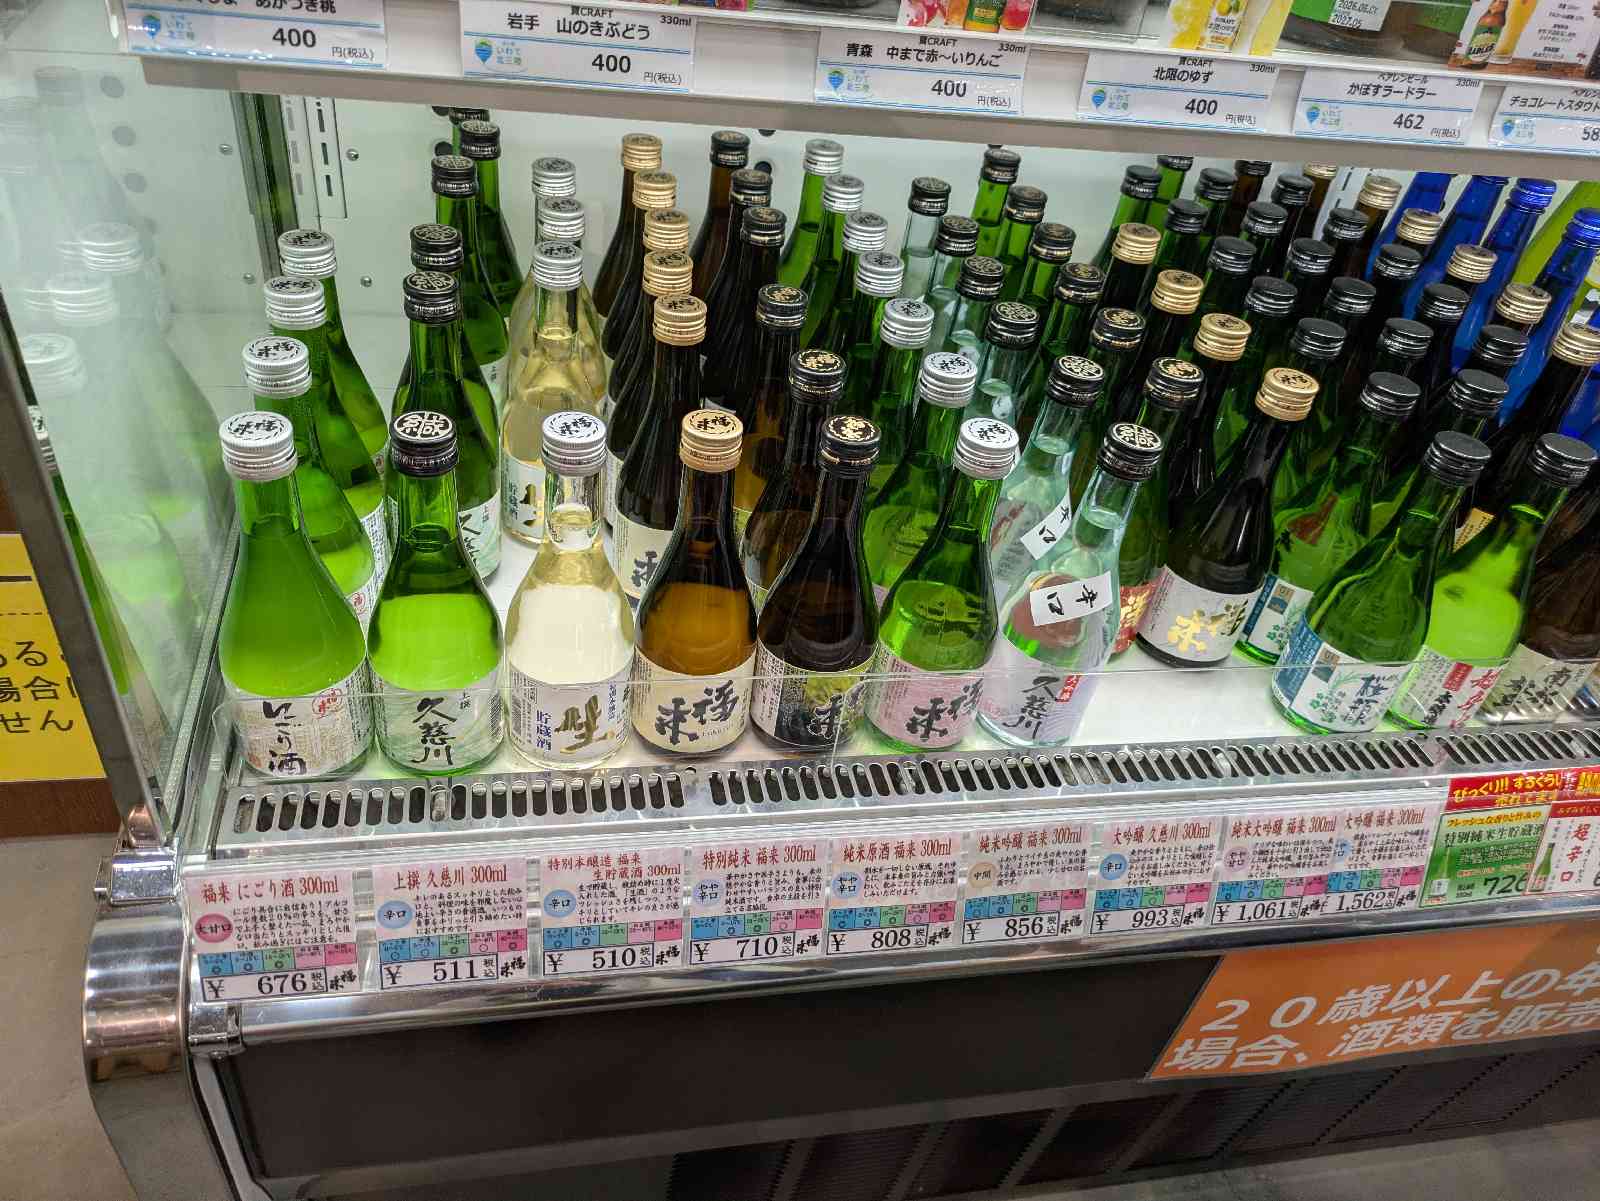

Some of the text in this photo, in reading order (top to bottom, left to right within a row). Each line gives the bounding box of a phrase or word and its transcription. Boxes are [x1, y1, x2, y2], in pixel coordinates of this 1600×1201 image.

[507, 12, 651, 41] 岩手 山のきぶどう
[660, 15, 692, 27] 330ml
[273, 28, 317, 48] 400
[998, 42, 1026, 53] 330ml
[331, 47, 375, 60] 円(税込)
[846, 43, 873, 58] 青森
[592, 54, 631, 73] 400
[643, 71, 682, 85] 円(税込)
[932, 80, 967, 97] 400
[1455, 78, 1481, 88] 330ml
[1346, 81, 1437, 100] かぼすラードラー
[977, 95, 1011, 108] 円(税込)
[1184, 98, 1218, 116] 400
[1393, 113, 1425, 130] 462
[1002, 676, 1060, 740] 久慈川
[262, 701, 307, 776] にごり酒
[411, 697, 458, 765] 久慈川
[1397, 807, 1426, 825] 300ml
[1113, 821, 1212, 845] 大吟醸 久慈川 300ml
[1231, 817, 1284, 840] 純米大吟醸
[1309, 814, 1337, 833] 300ml
[843, 838, 952, 862] 純米原酒 福来 300ml
[979, 826, 1082, 853] 純米吟醸 福来 300ml
[547, 852, 641, 871] 特別本醸造 福来
[703, 844, 817, 870] 特別純米 福来 300ml
[1559, 823, 1591, 882] 超辛口
[394, 864, 508, 891] 上撰 久慈川 300ml
[593, 863, 681, 880] 生貯蔵酒 300ml
[974, 869, 992, 880] 中間
[1104, 861, 1122, 873] 辛口
[202, 875, 339, 904] 福来 にごり酒 300ml
[699, 891, 718, 903] 辛口
[548, 897, 571, 910] 辛口
[1216, 901, 1286, 923] ¥ 1,061
[1318, 891, 1386, 912] ¥ 1,562
[966, 916, 1043, 941] ¥ 856
[1096, 909, 1169, 931] ¥ 993
[693, 936, 778, 962] ¥ 710
[830, 928, 912, 952] ¥ 808
[546, 947, 636, 973] ¥ 510
[384, 959, 478, 985] ¥ 511
[206, 972, 307, 998] ¥ 676
